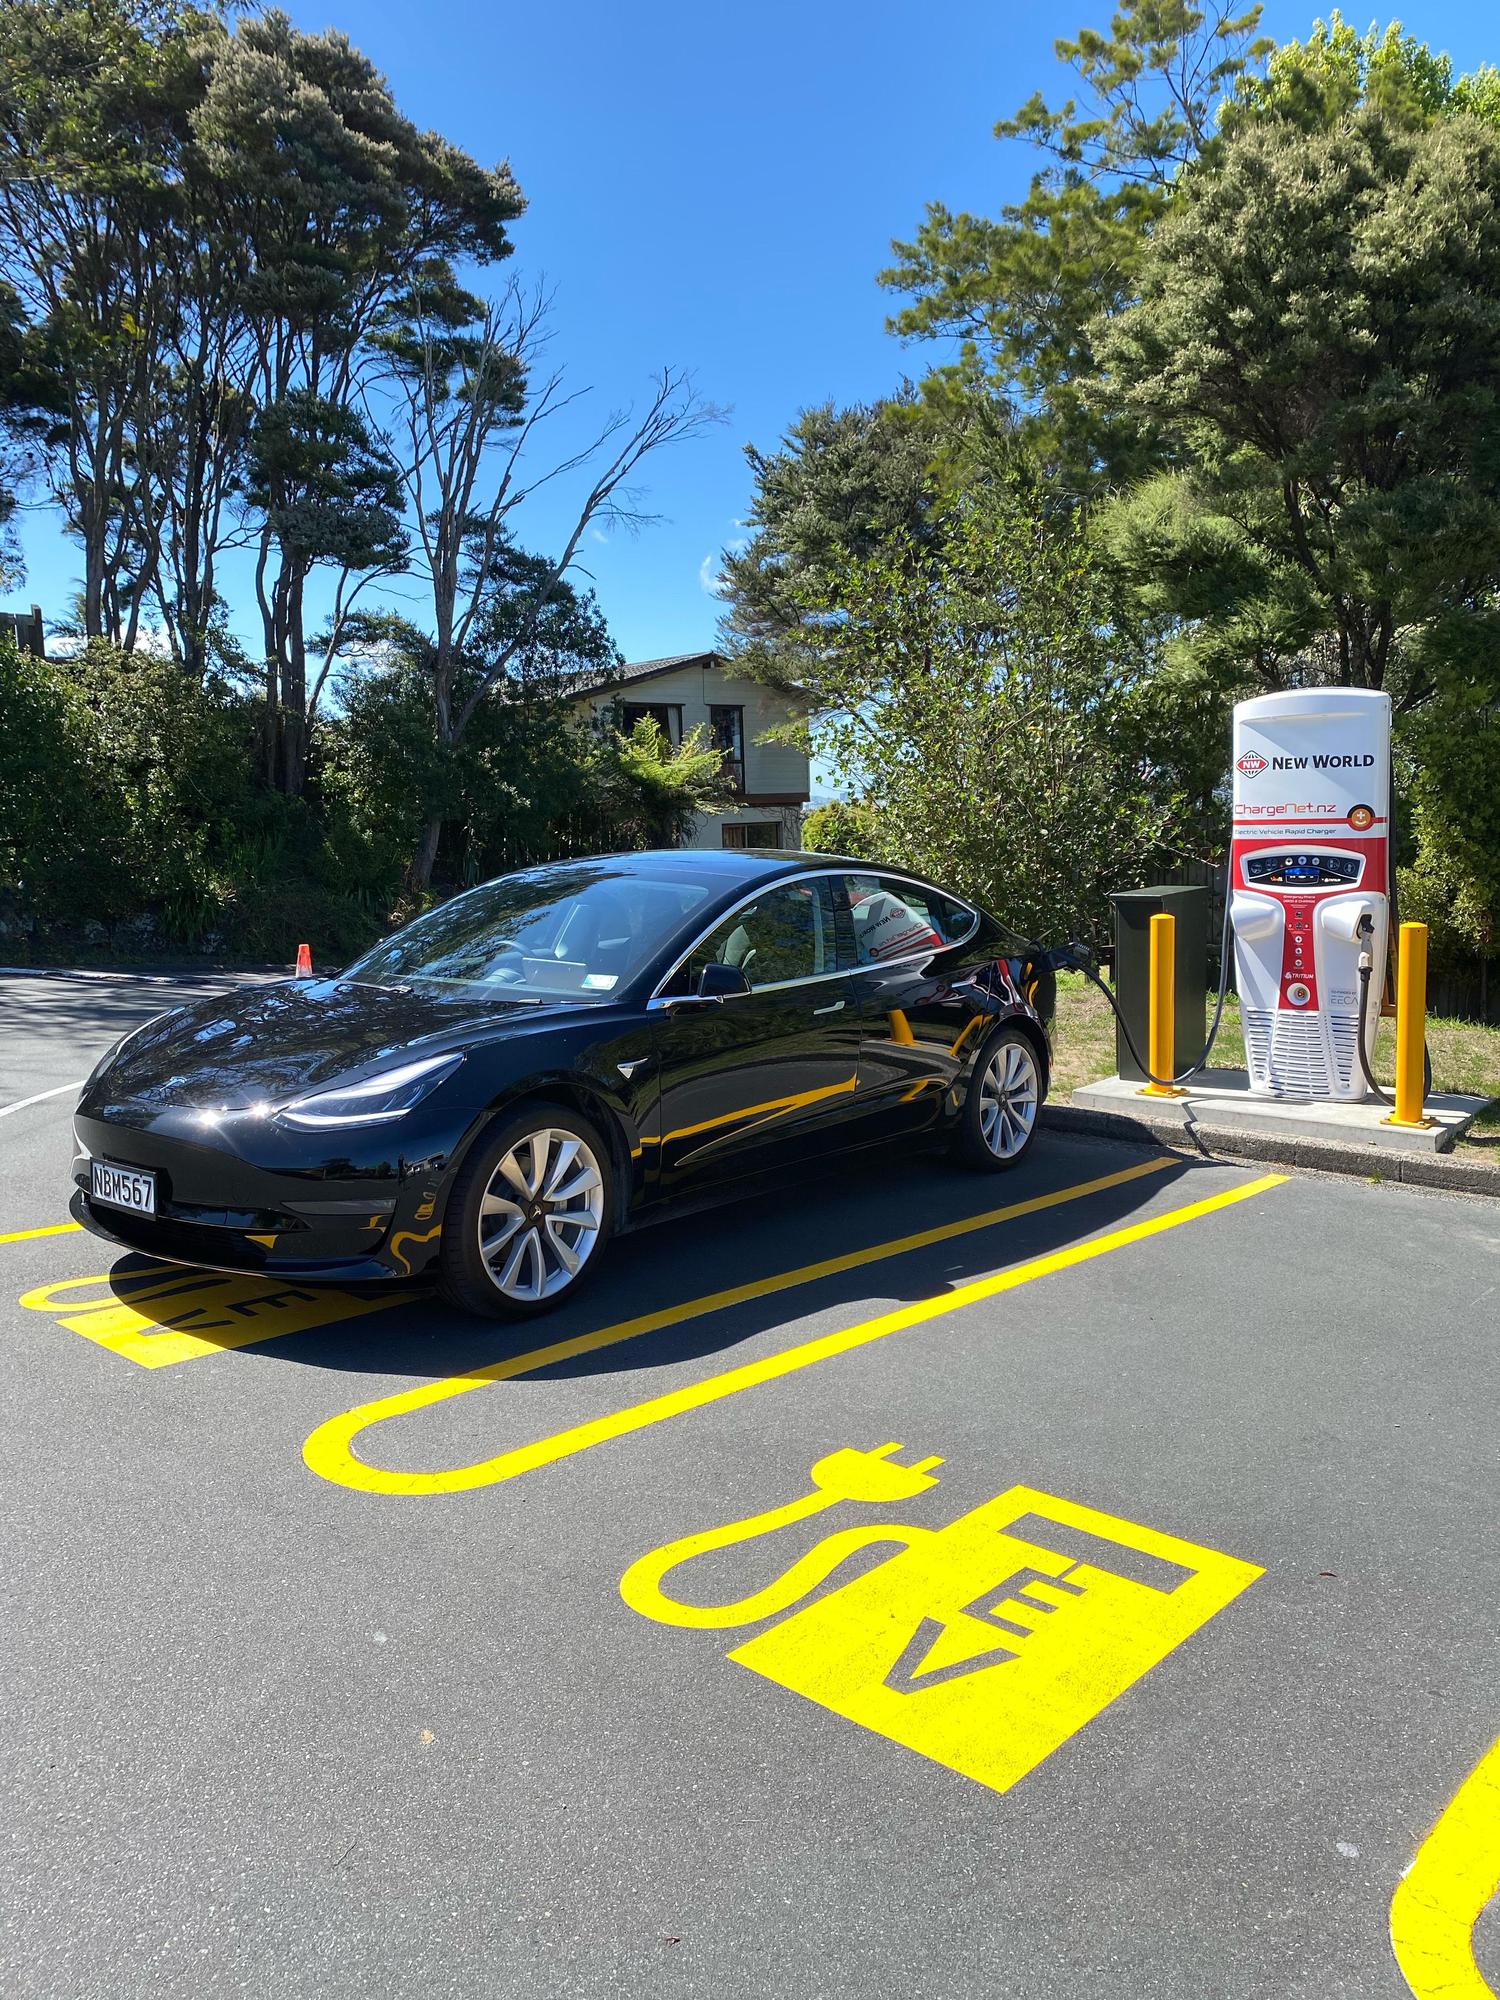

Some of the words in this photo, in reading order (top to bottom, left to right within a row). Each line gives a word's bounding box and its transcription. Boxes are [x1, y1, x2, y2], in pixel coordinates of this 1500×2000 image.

[1272, 757, 1308, 770] NEW
[1313, 755, 1375, 769] WORLD
[1235, 803, 1336, 816] ChargeNet.nz
[1285, 828, 1306, 836] Rapid
[1306, 828, 1337, 836] Charger
[94, 1166, 152, 1208] NBM567
